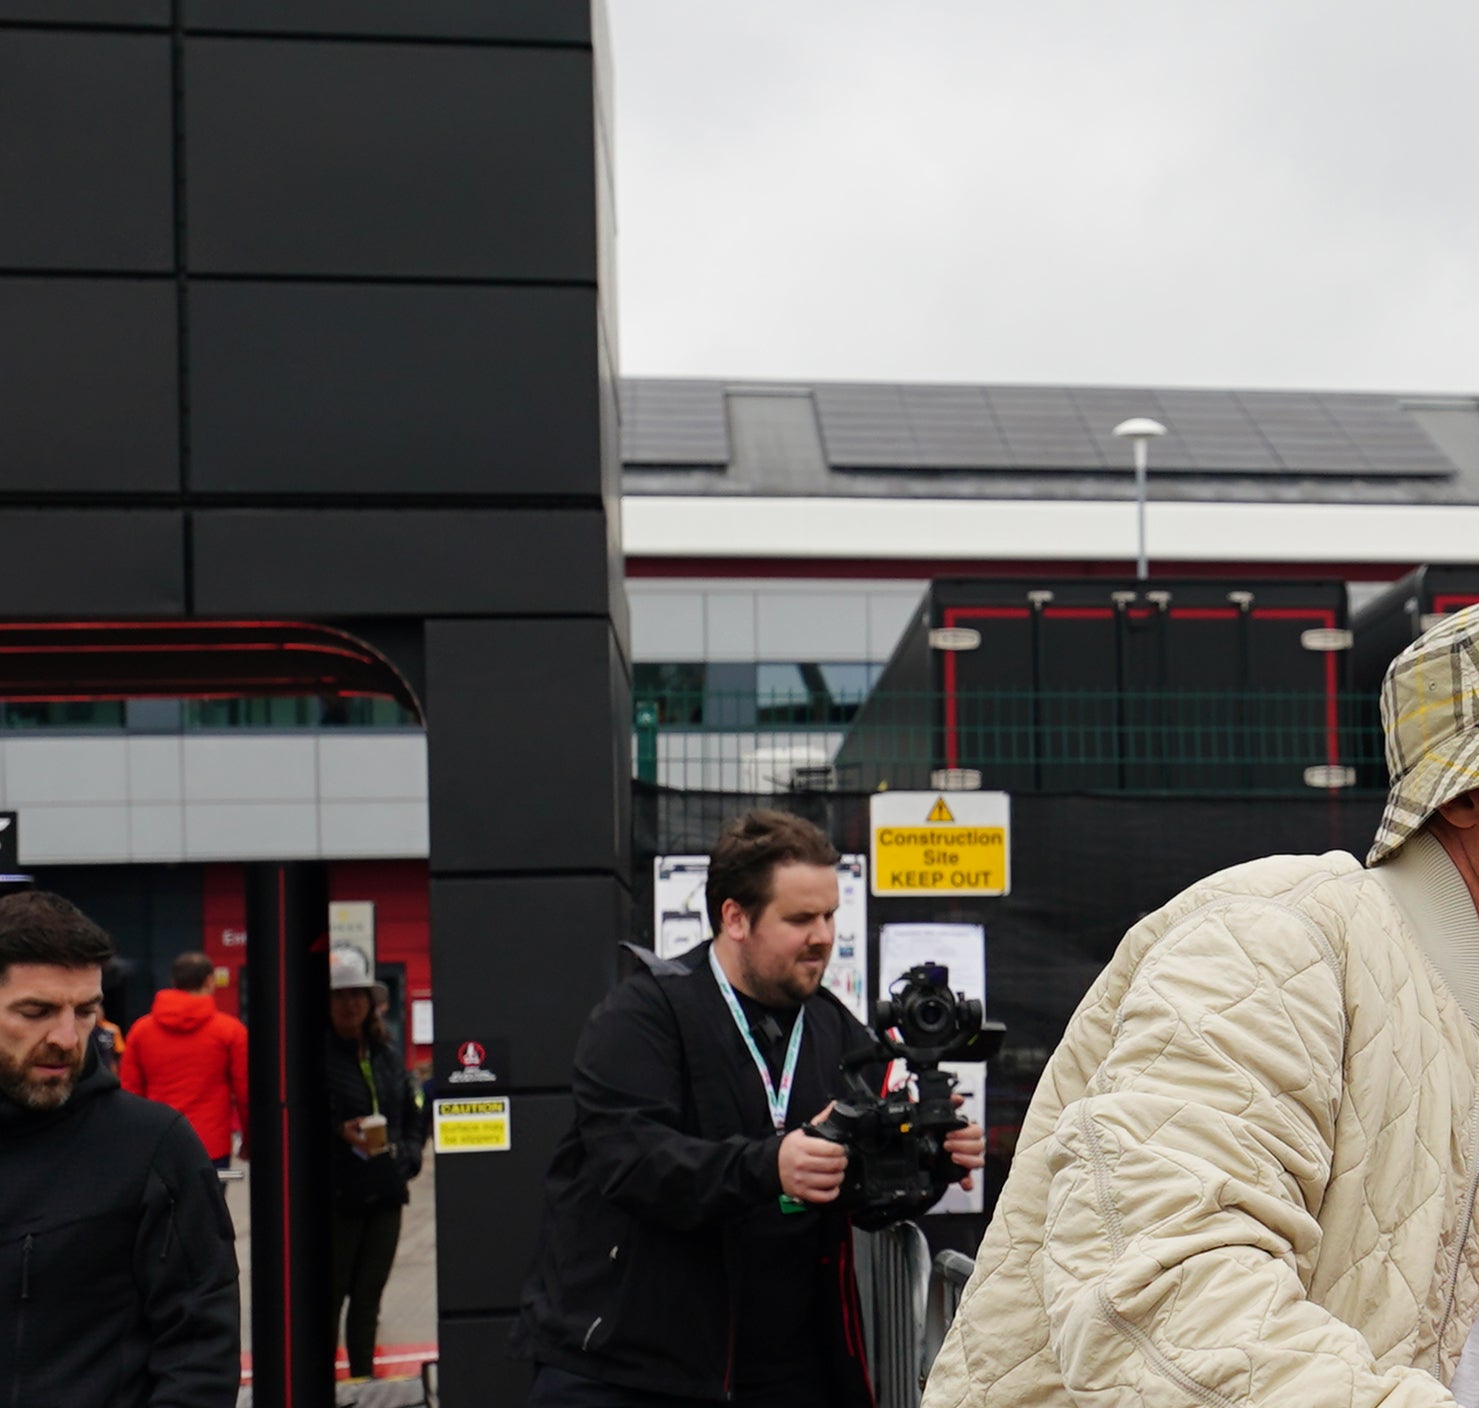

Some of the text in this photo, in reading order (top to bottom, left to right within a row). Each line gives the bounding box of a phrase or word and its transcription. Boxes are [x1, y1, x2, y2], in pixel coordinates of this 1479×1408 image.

[879, 829, 1003, 846] Construction
[923, 849, 960, 866] Site
[890, 871, 992, 888] KEEP OUT
[440, 1103, 504, 1115] CAUTION
